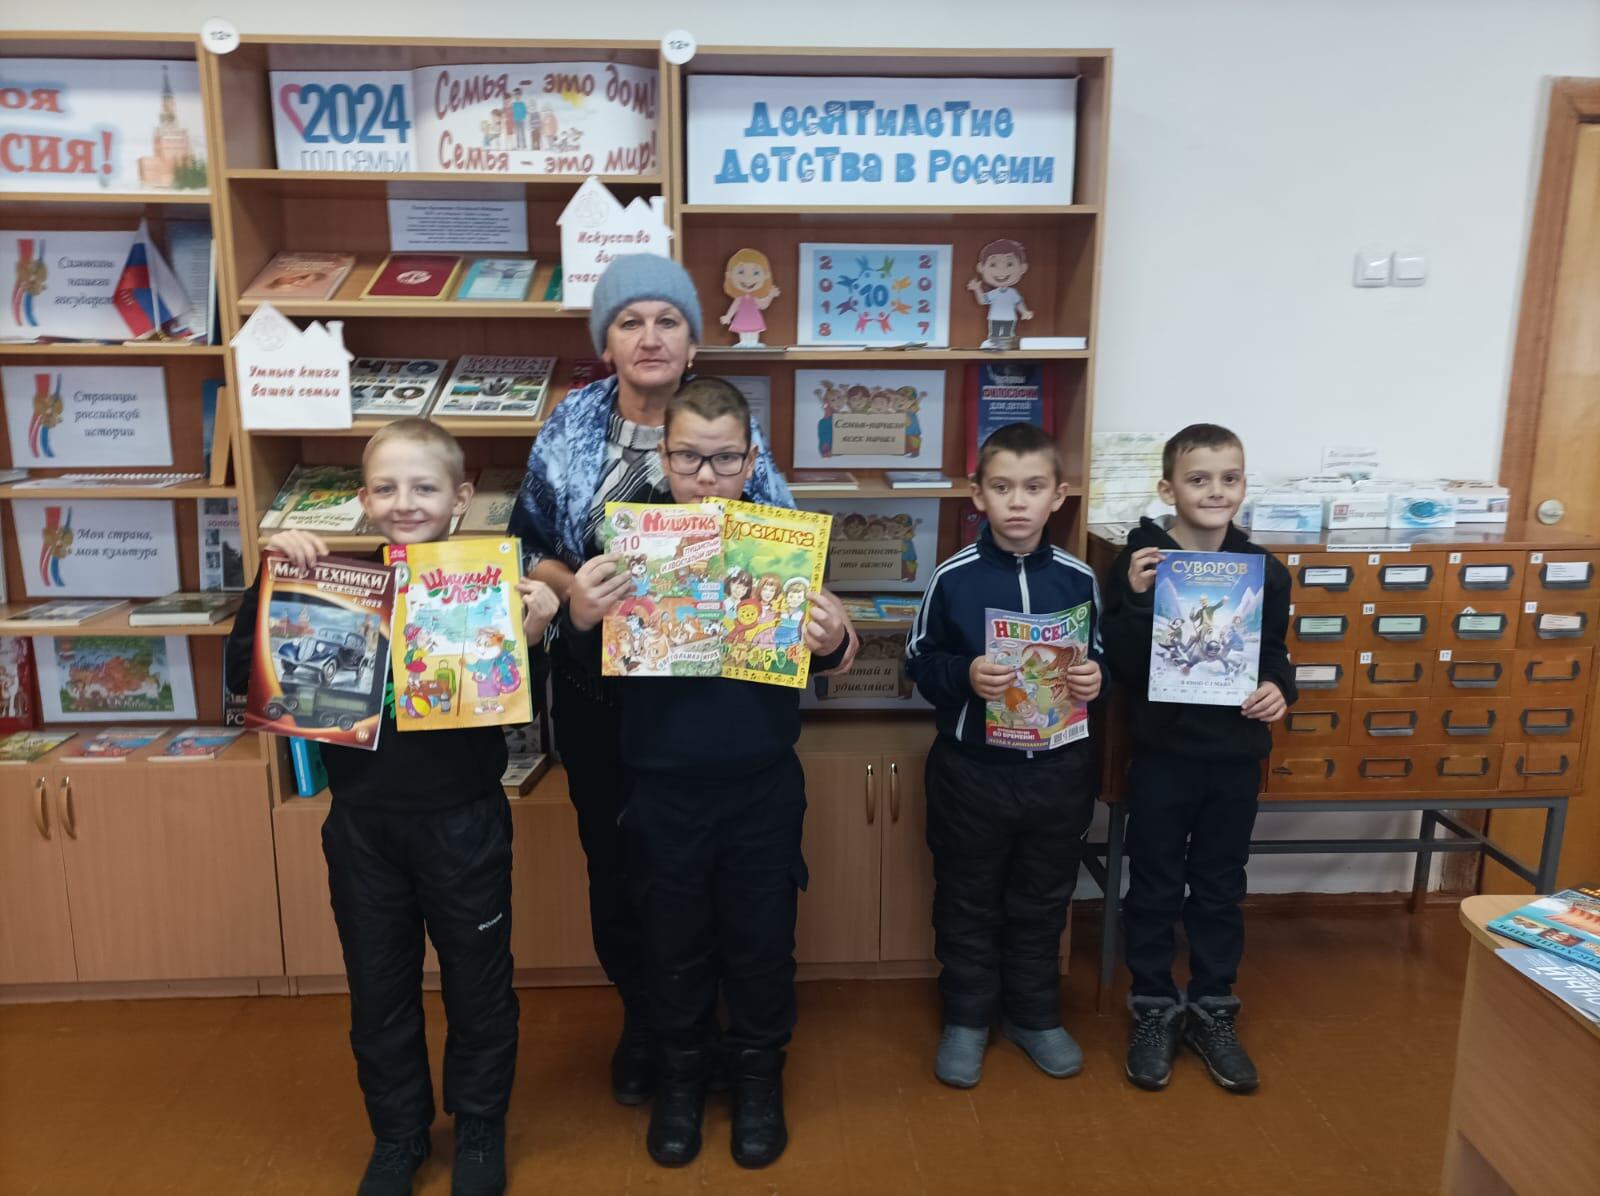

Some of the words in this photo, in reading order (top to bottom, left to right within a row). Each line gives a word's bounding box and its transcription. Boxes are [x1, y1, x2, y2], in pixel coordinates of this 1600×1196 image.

[434, 70, 510, 120] Семья
[542, 73, 596, 97] это
[605, 63, 656, 119] дом!
[299, 82, 411, 144] 2024
[437, 130, 510, 171] Семья
[543, 153, 595, 173] это
[604, 131, 657, 175] мир!
[927, 149, 1056, 184] России
[576, 230, 651, 246] Искусство
[859, 283, 890, 308] 10
[248, 364, 296, 378] Умные
[298, 364, 341, 378] книги
[73, 390, 138, 405] Страницы
[298, 386, 341, 397] семьи
[74, 408, 141, 423] российской
[84, 427, 136, 440] истории
[77, 528, 104, 540] Моя
[107, 530, 153, 543] страна,
[620, 535, 640, 552] 10
[74, 548, 99, 557] моя
[102, 548, 158, 560] культура
[1171, 560, 1248, 575] СУВОРОВ
[314, 567, 383, 589] ТЕХНИКИ
[993, 617, 1076, 642] НЕПОСЕДА
